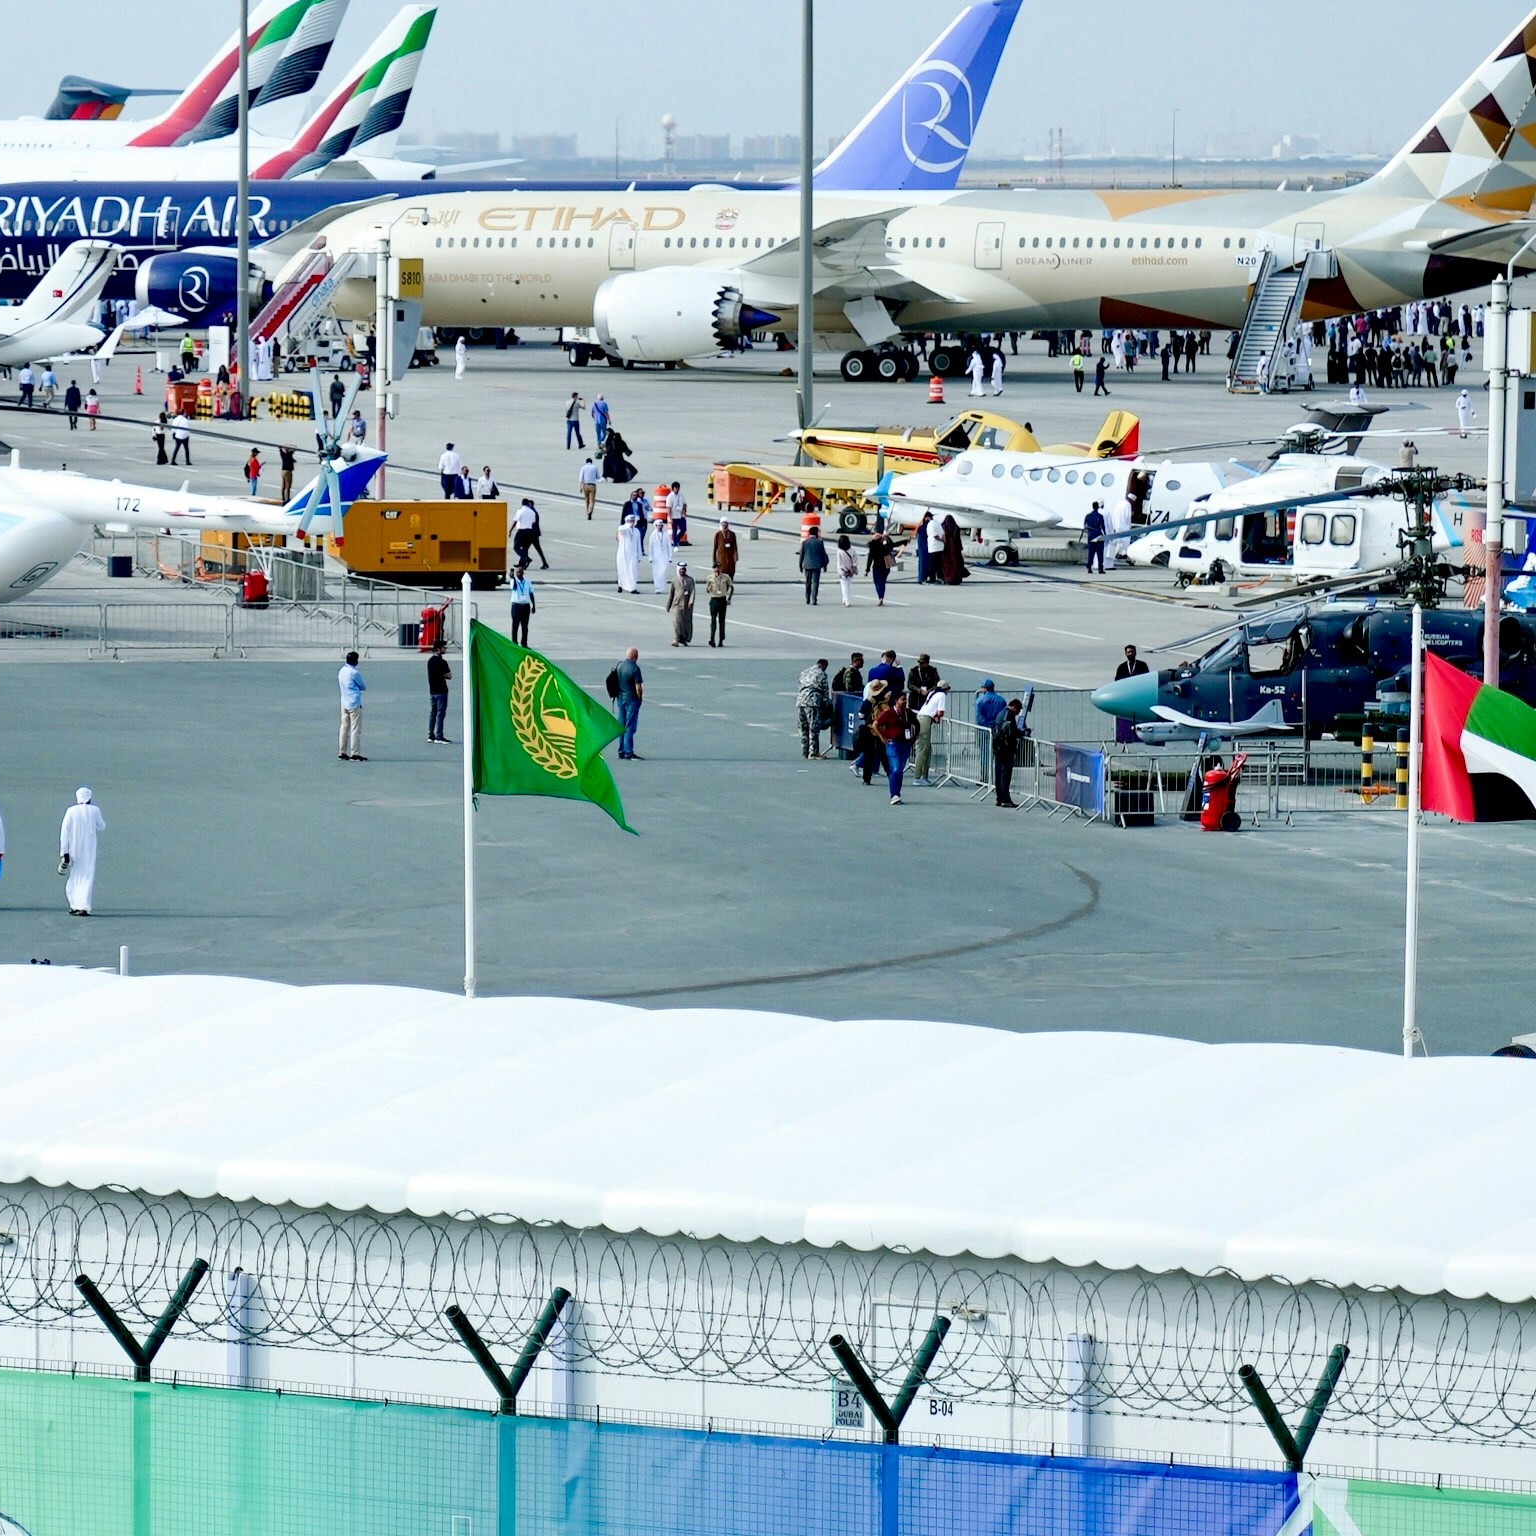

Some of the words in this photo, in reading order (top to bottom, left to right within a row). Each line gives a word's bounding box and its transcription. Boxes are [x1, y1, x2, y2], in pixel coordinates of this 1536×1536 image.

[182, 196, 272, 237] AIR
[478, 207, 686, 231] ETIHAD
[1131, 256, 1188, 266] etihad.com
[401, 271, 421, 285] S810
[428, 273, 446, 282] ABU
[449, 273, 479, 282] DHABI
[481, 274, 494, 282] TO
[497, 274, 517, 283] THE
[518, 274, 552, 283] WORLD
[116, 497, 141, 512] 172
[385, 511, 398, 519] CAT
[1424, 639, 1463, 647] HELICOPTERS
[1259, 684, 1286, 695] Ka-52
[838, 1390, 862, 1408] B4
[929, 1399, 953, 1416] B-04
[838, 1409, 863, 1419] DUBAI
[835, 1417, 863, 1427] POLICE
